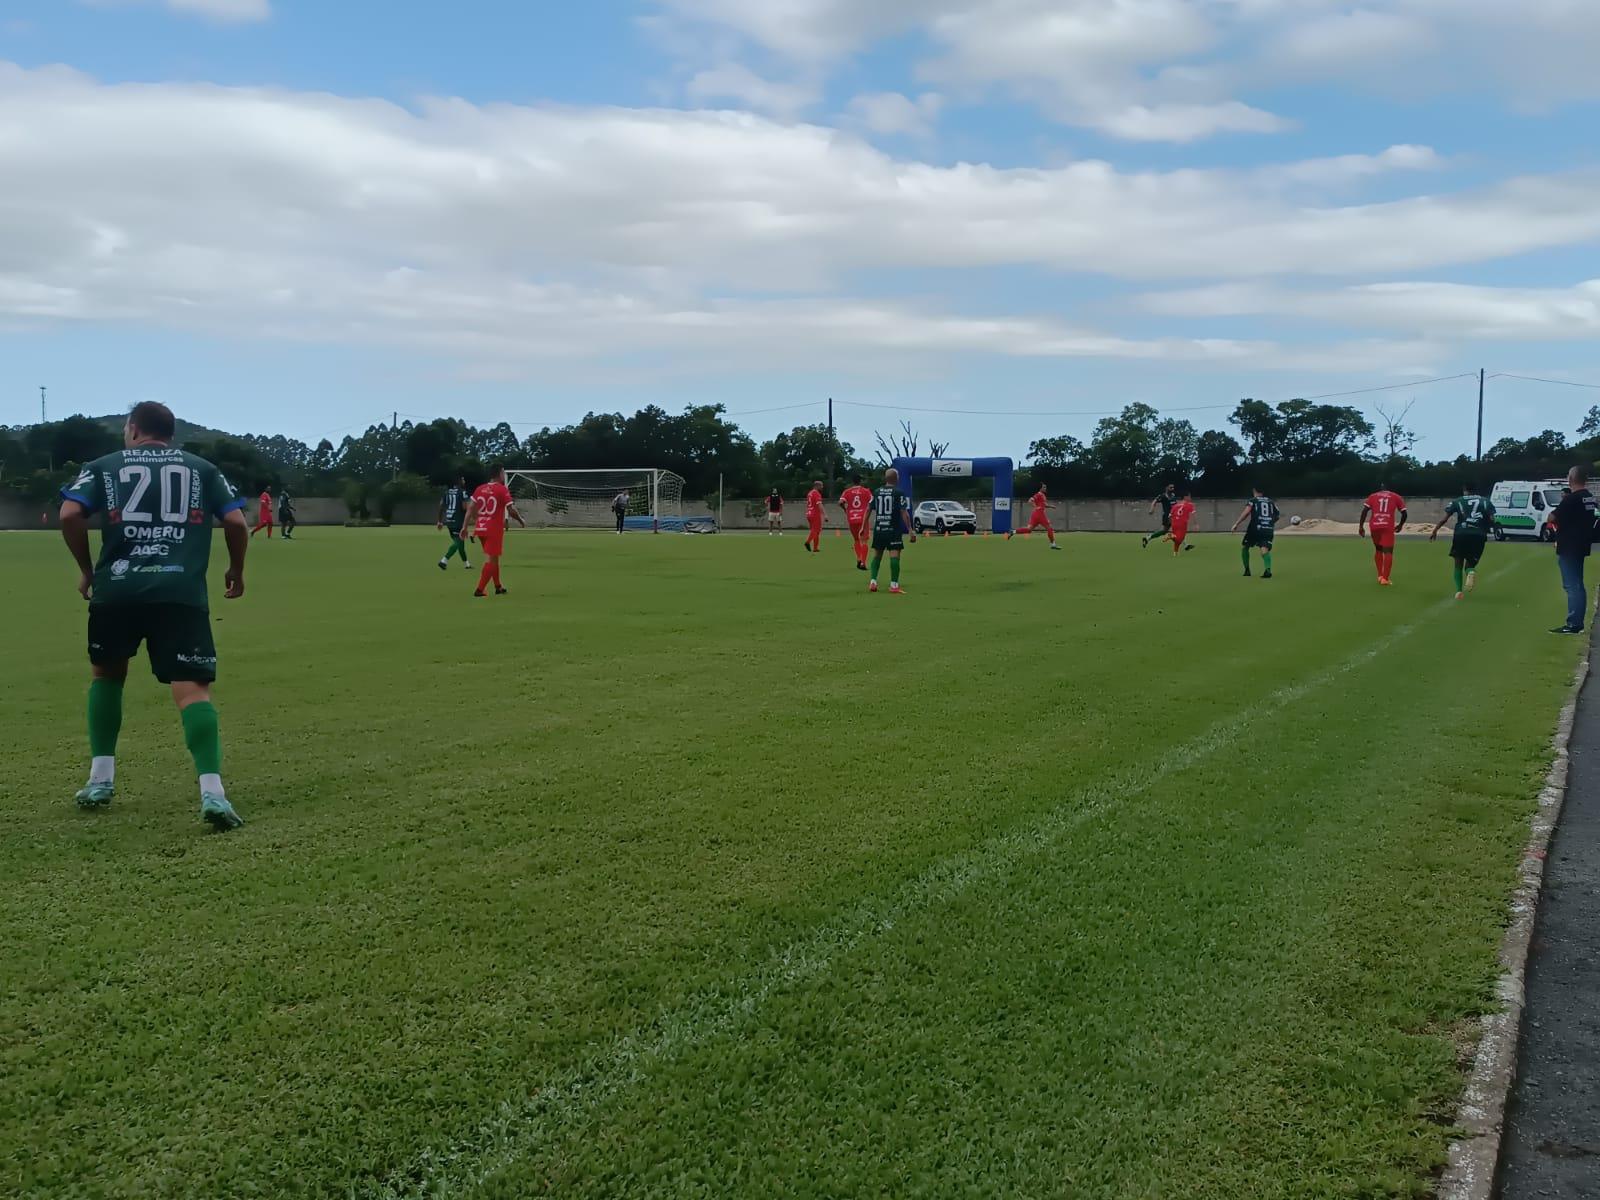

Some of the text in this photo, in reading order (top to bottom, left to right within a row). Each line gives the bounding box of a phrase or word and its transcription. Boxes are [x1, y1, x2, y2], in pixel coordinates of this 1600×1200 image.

[122, 449, 183, 457] REALIZA
[118, 464, 191, 524] 20
[852, 495, 861, 508] 8
[448, 494, 457, 510] 11
[476, 495, 498, 516] 20
[877, 495, 893, 515] 10
[1261, 502, 1269, 516] 8
[1379, 497, 1389, 512] 11
[1467, 498, 1480, 517] 7
[123, 525, 186, 540] OMERU
